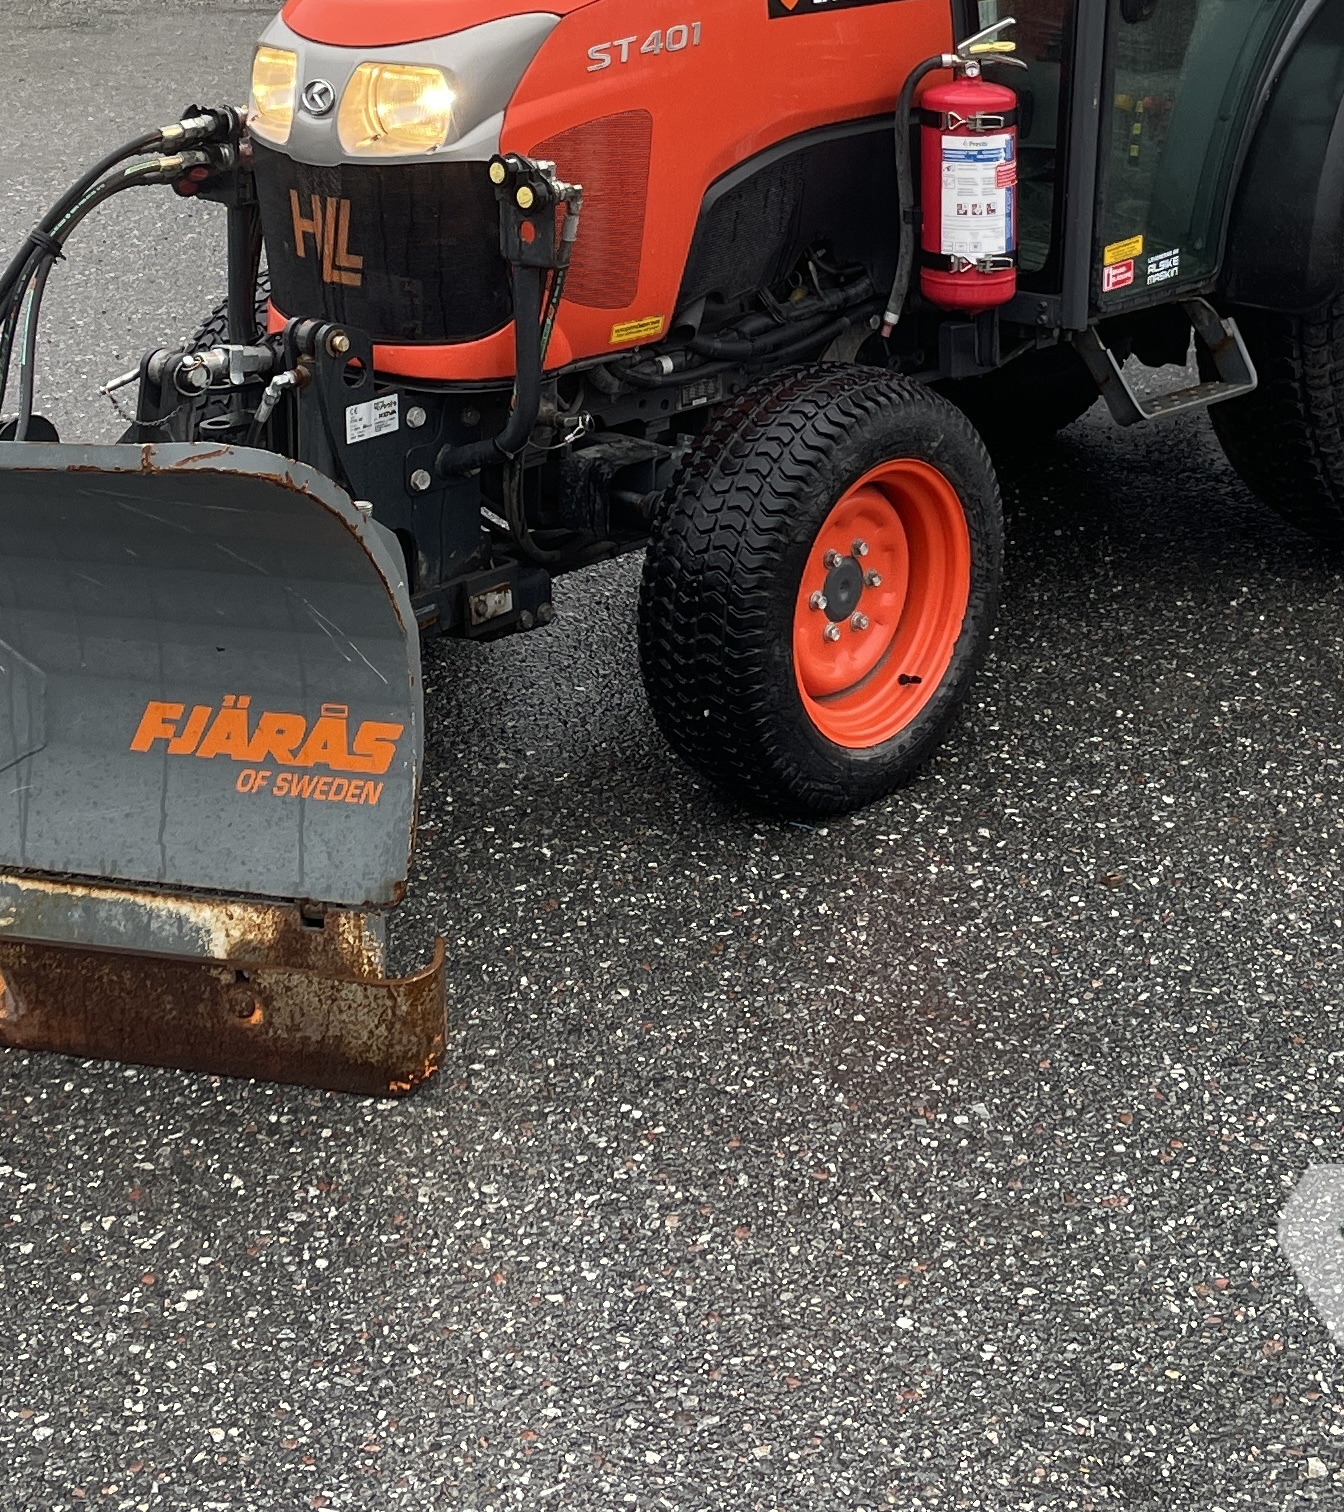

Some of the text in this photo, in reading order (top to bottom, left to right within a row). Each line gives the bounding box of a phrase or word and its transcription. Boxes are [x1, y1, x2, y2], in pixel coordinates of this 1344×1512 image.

[129, 693, 405, 775] FJÄRÅS
[235, 768, 384, 806] OF SWEDEN
